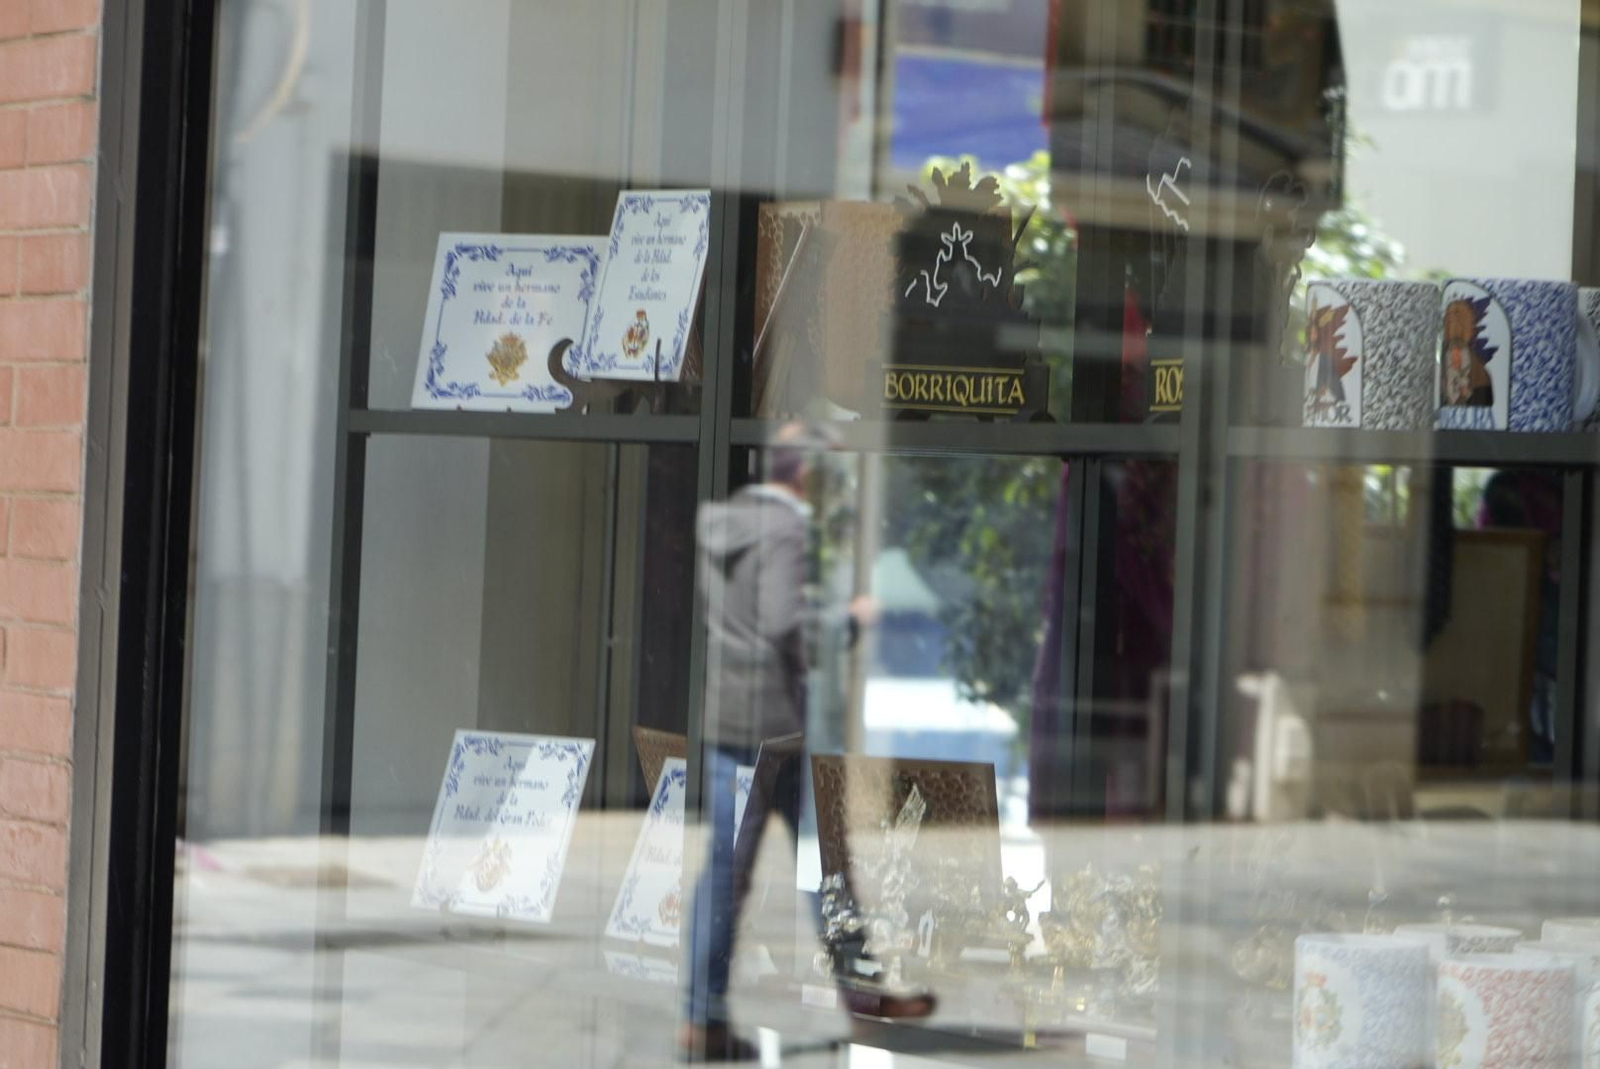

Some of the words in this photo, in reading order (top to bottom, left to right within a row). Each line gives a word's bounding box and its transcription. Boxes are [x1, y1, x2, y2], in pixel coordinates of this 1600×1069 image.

[497, 283, 511, 293] un
[514, 280, 561, 293] hermano
[501, 295, 513, 309] de
[516, 295, 526, 309] la
[509, 311, 521, 325] de
[524, 312, 535, 325] la
[884, 372, 1025, 407] BORRIQUITA
